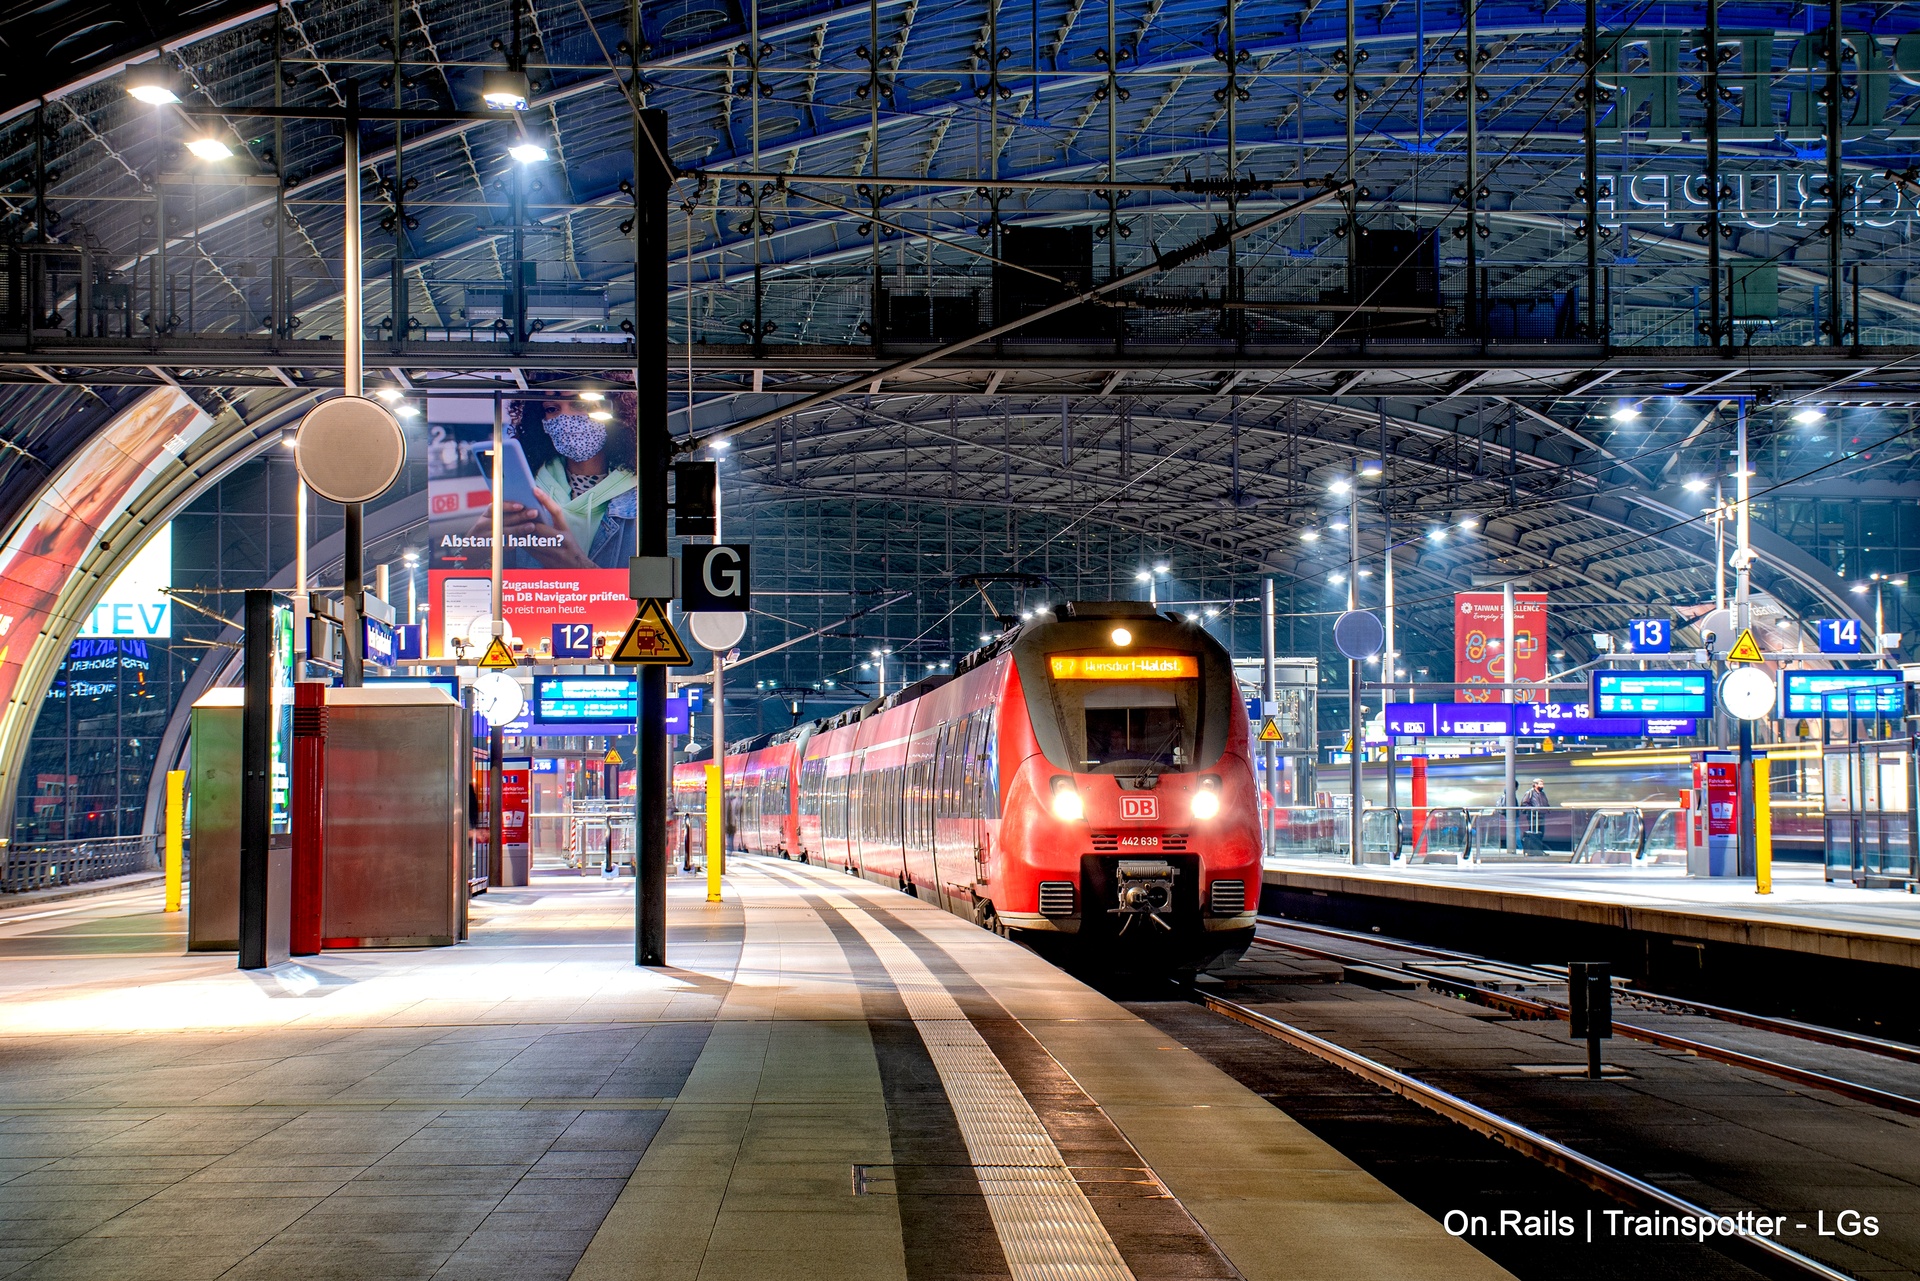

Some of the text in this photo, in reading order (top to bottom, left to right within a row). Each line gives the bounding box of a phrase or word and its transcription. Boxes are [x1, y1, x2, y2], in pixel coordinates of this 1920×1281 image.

[441, 534, 564, 549] Abstan halten?
[703, 547, 742, 597] G
[502, 579, 580, 592] Zugauslastung
[517, 592, 532, 602] DB
[535, 592, 588, 604] Navigator
[590, 592, 629, 604] prüfen.
[514, 604, 534, 614] reist
[536, 606, 556, 614] man
[558, 604, 587, 614] heute.
[1474, 604, 1540, 612] TAIWAN EELLENCE
[79, 604, 167, 634] TEV
[560, 624, 589, 649] 12
[1633, 620, 1662, 646] 13
[1828, 620, 1858, 646] 14
[688, 688, 700, 707] F
[1532, 704, 1561, 719] 1-12
[1573, 704, 1589, 719] 15
[1125, 800, 1154, 816] DB
[1122, 836, 1158, 846] 442 639
